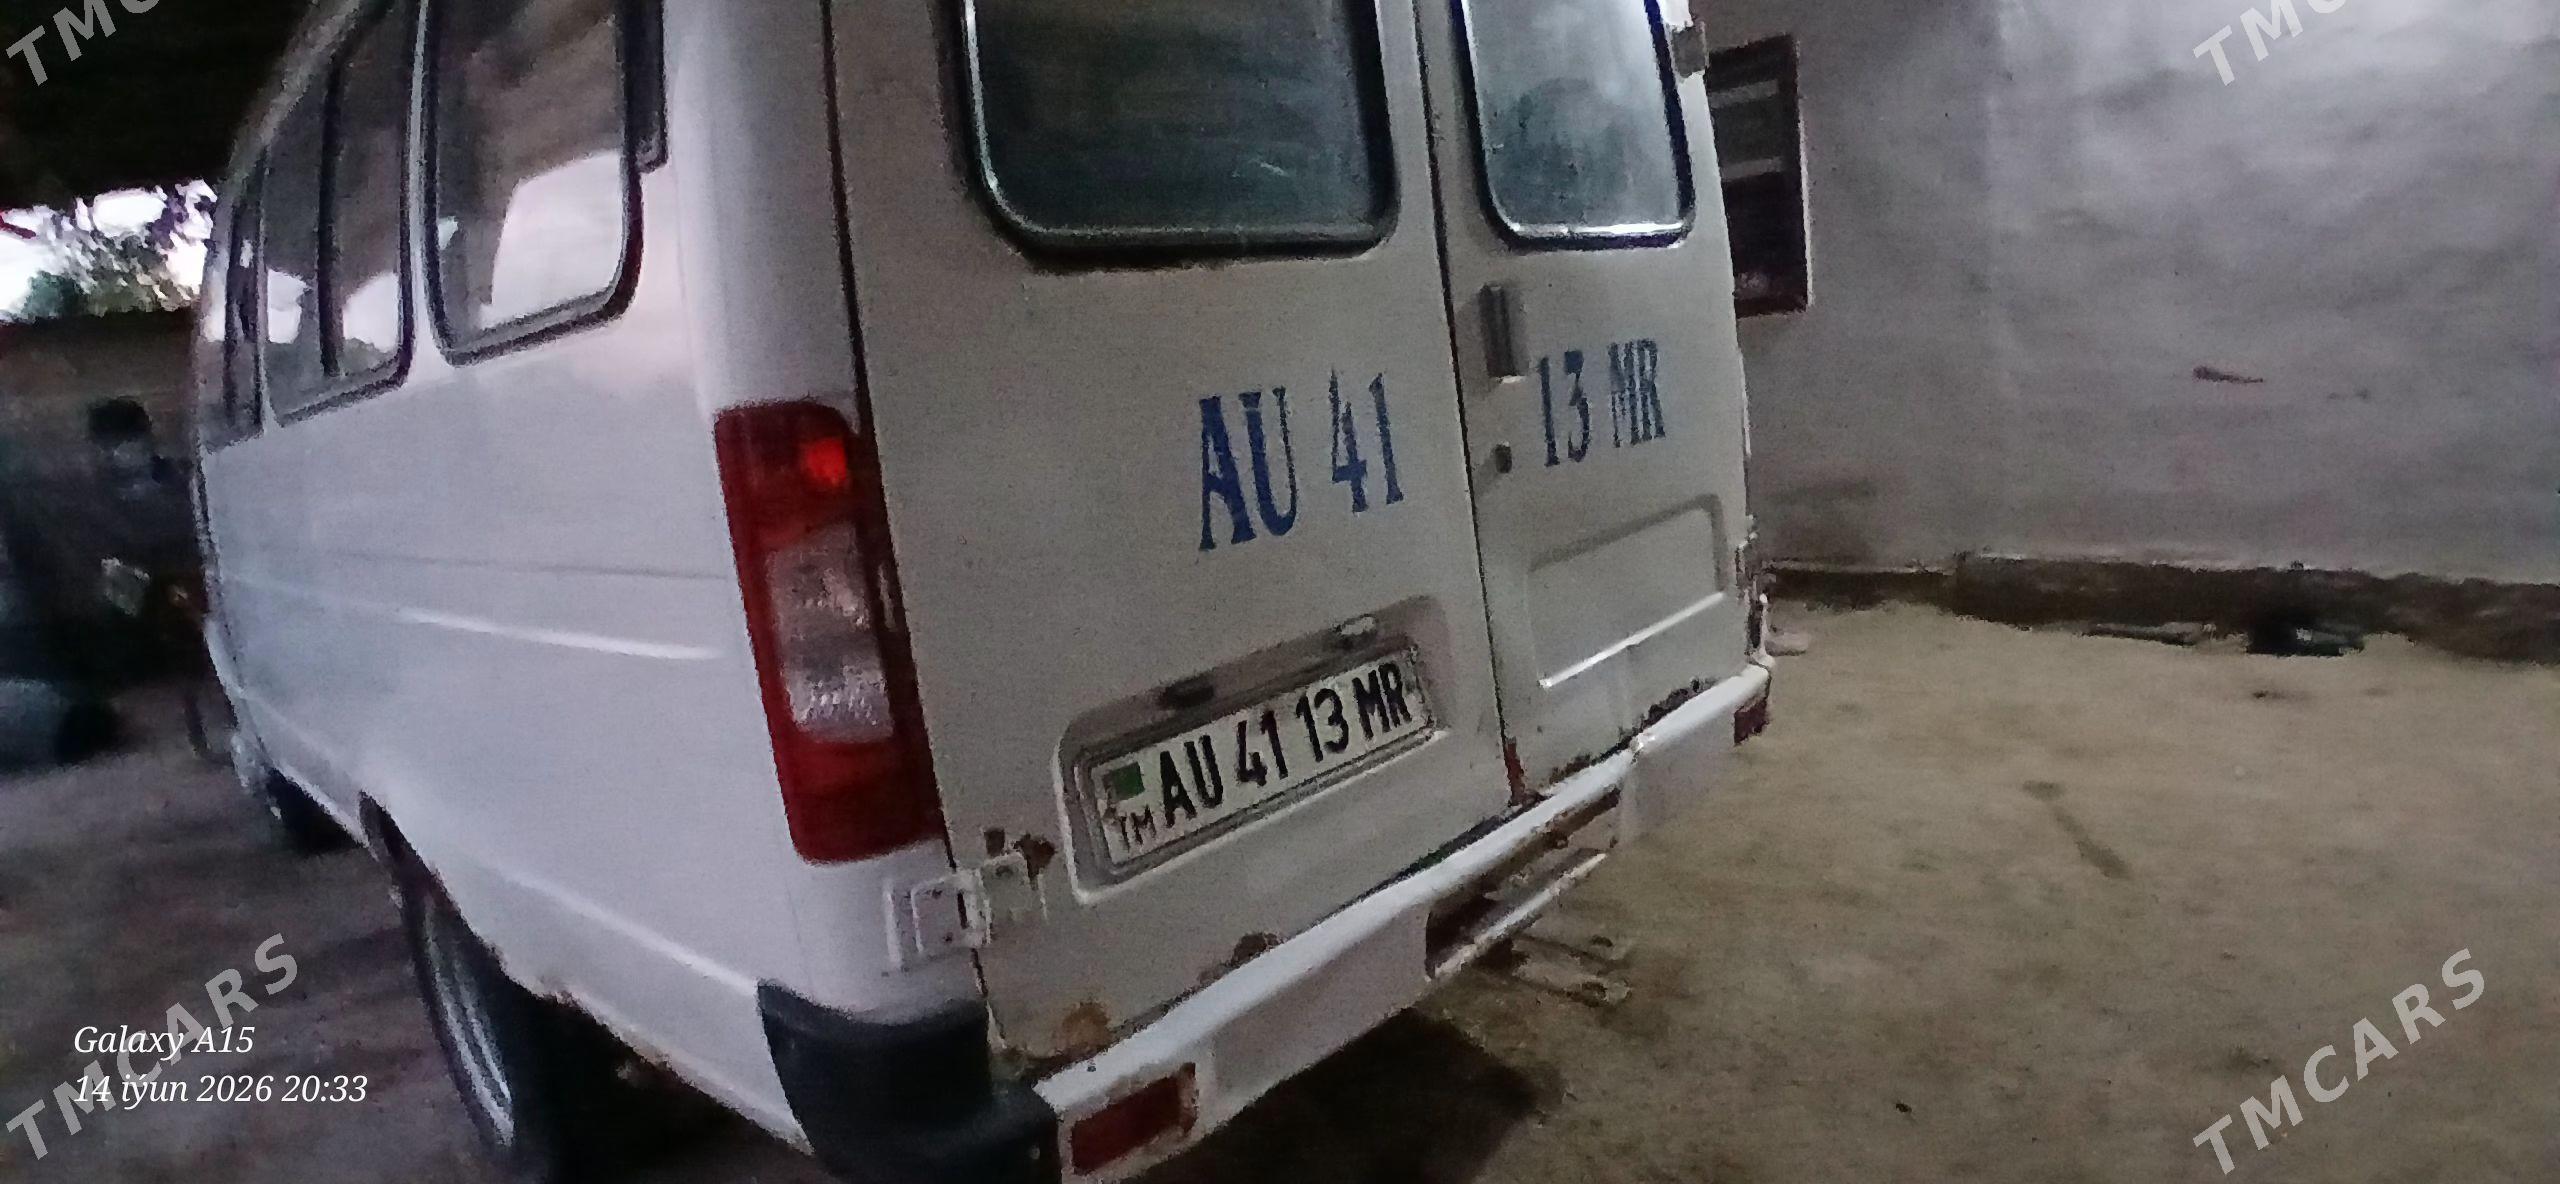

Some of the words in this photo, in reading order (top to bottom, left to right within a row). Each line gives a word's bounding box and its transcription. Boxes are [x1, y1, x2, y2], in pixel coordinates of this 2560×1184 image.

[1199, 385, 1298, 551] AU
[1328, 366, 1404, 514] 41
[1536, 350, 1591, 467] 13
[1607, 338, 1666, 448] MR
[1160, 735, 1223, 828] AU
[1236, 710, 1289, 786] 41
[1295, 688, 1350, 763] 13
[1352, 661, 1413, 742] MR
[1103, 806, 1157, 854] TM
